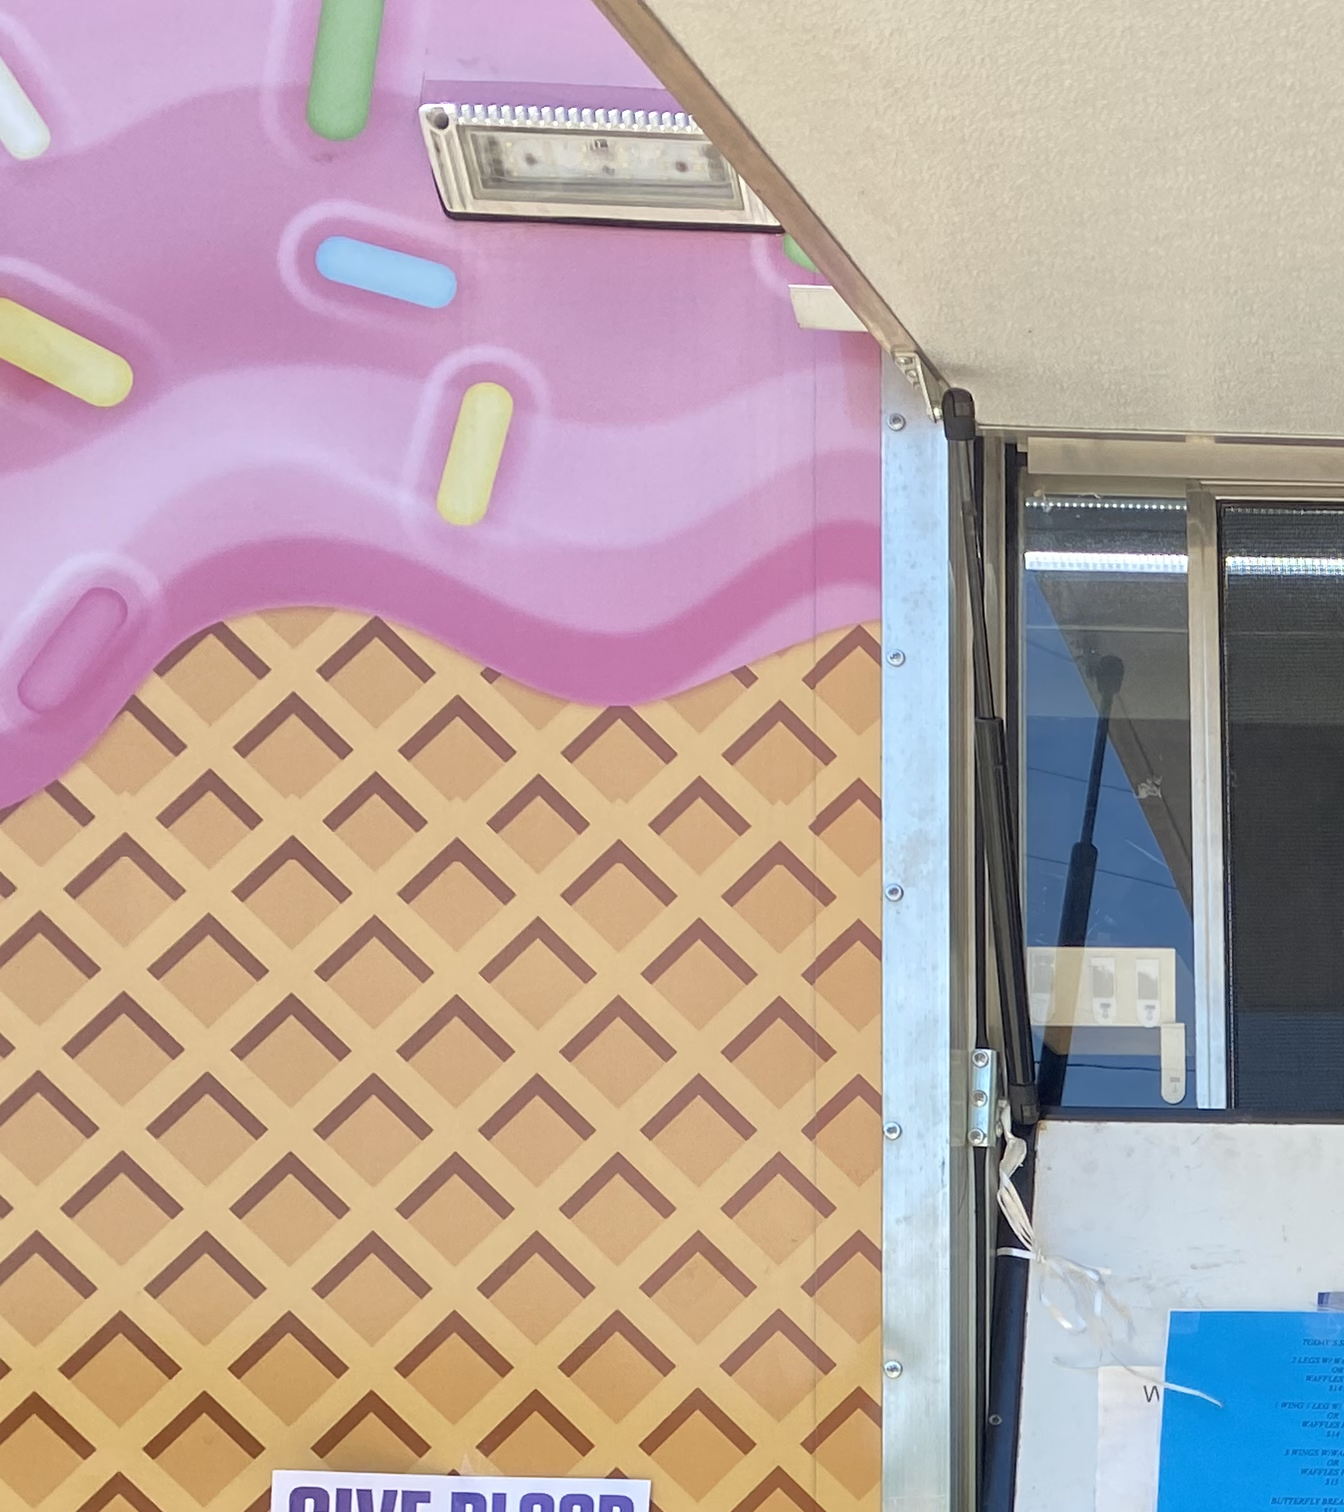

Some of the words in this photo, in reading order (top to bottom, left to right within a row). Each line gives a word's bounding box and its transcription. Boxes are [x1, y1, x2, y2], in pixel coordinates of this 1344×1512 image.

[1298, 1356, 1320, 1364] LEGS
[1331, 1366, 1344, 1374] OR
[1305, 1374, 1344, 1383] WAFFLES
[1280, 1401, 1305, 1410] WING
[1326, 1411, 1340, 1420] OR
[1301, 1420, 1340, 1429] WAFFLES
[1290, 1448, 1319, 1457] WINGS
[1326, 1459, 1340, 1467] OR
[1300, 1467, 1340, 1476] WAFFLES
[1270, 1497, 1321, 1506] BUTTERFLY
